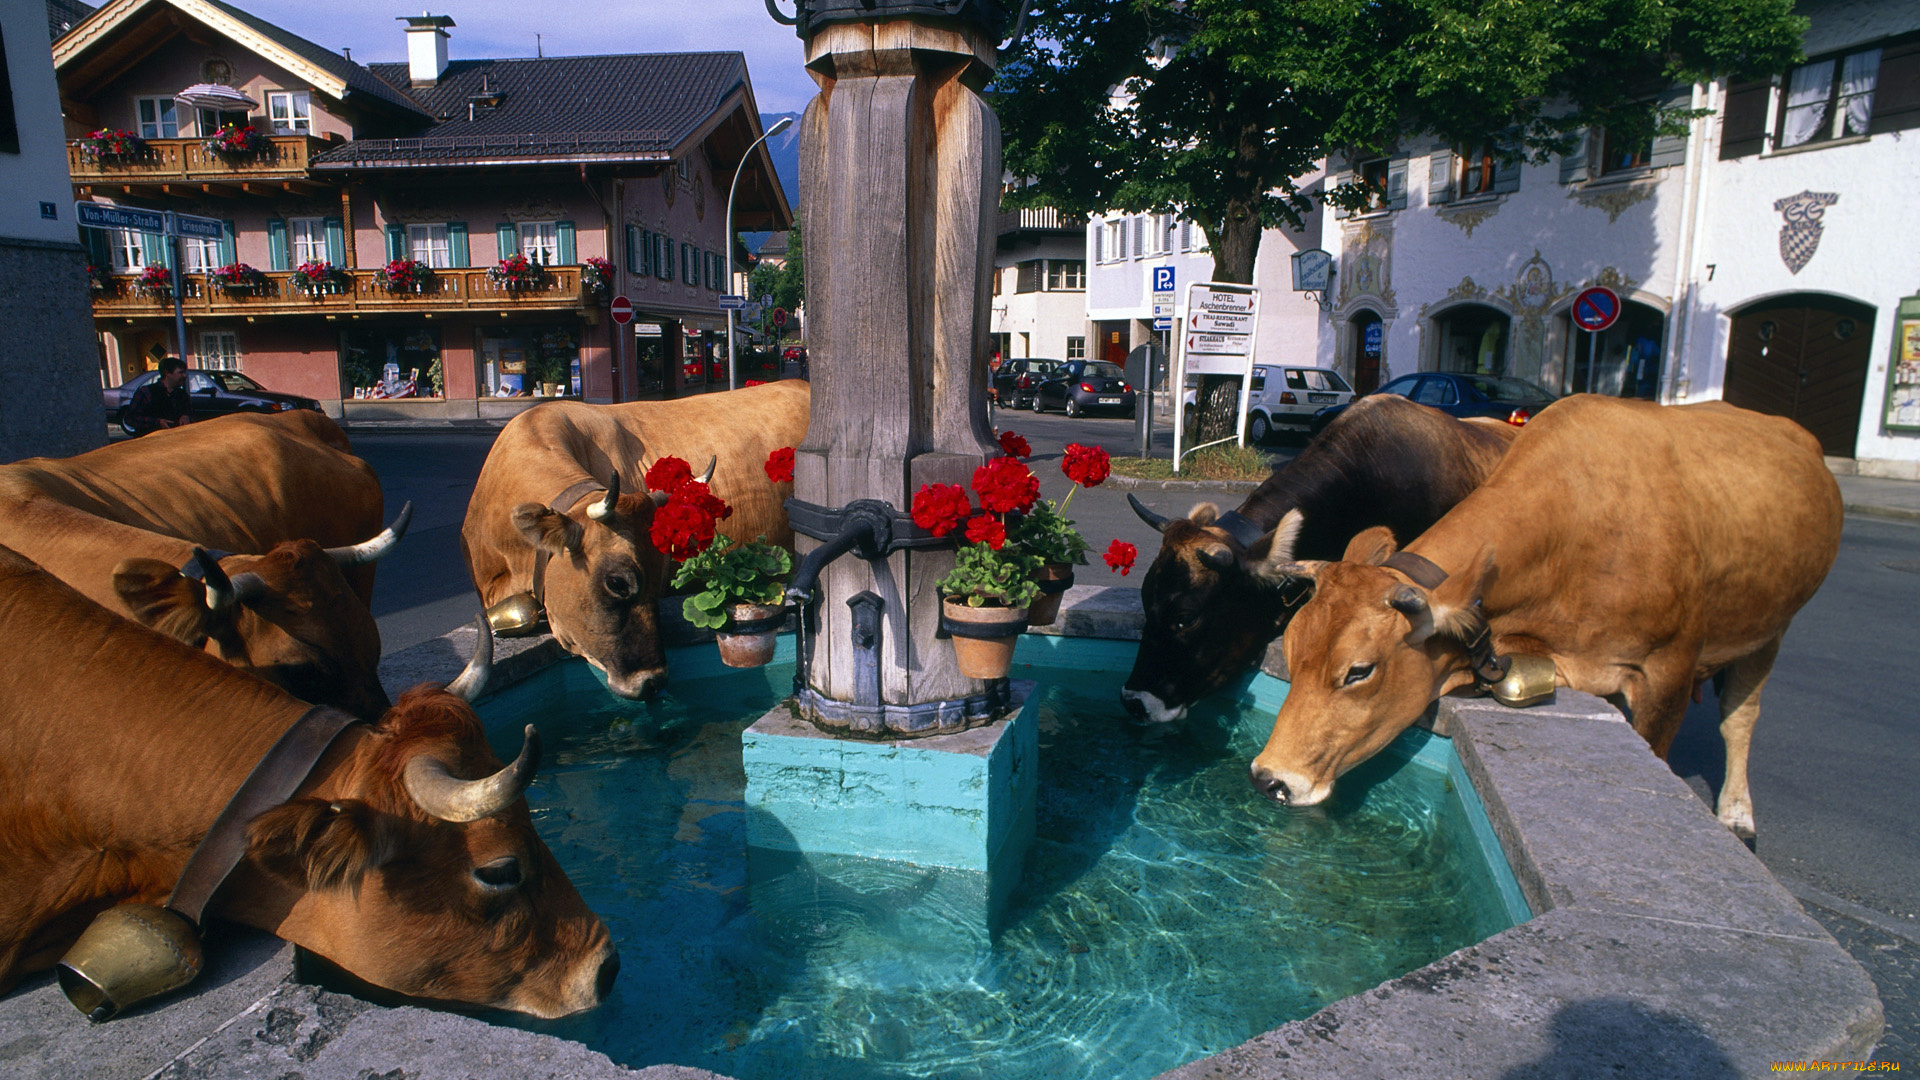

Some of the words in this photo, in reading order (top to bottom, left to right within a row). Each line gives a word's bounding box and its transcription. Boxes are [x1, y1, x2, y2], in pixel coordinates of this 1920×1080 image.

[45, 205, 51, 213] 1
[83, 207, 159, 228] Von-Müller-Straße
[181, 219, 217, 235] Griesstraße
[1706, 264, 1716, 281] 7
[1157, 269, 1171, 290] P
[1212, 293, 1236, 303] HOTEL
[1199, 301, 1247, 312] Aschenbrenner
[1202, 314, 1249, 322] THAI-RESTAURANT
[1214, 320, 1235, 328] Sawadi
[1199, 335, 1225, 343] STEAKHAUS
